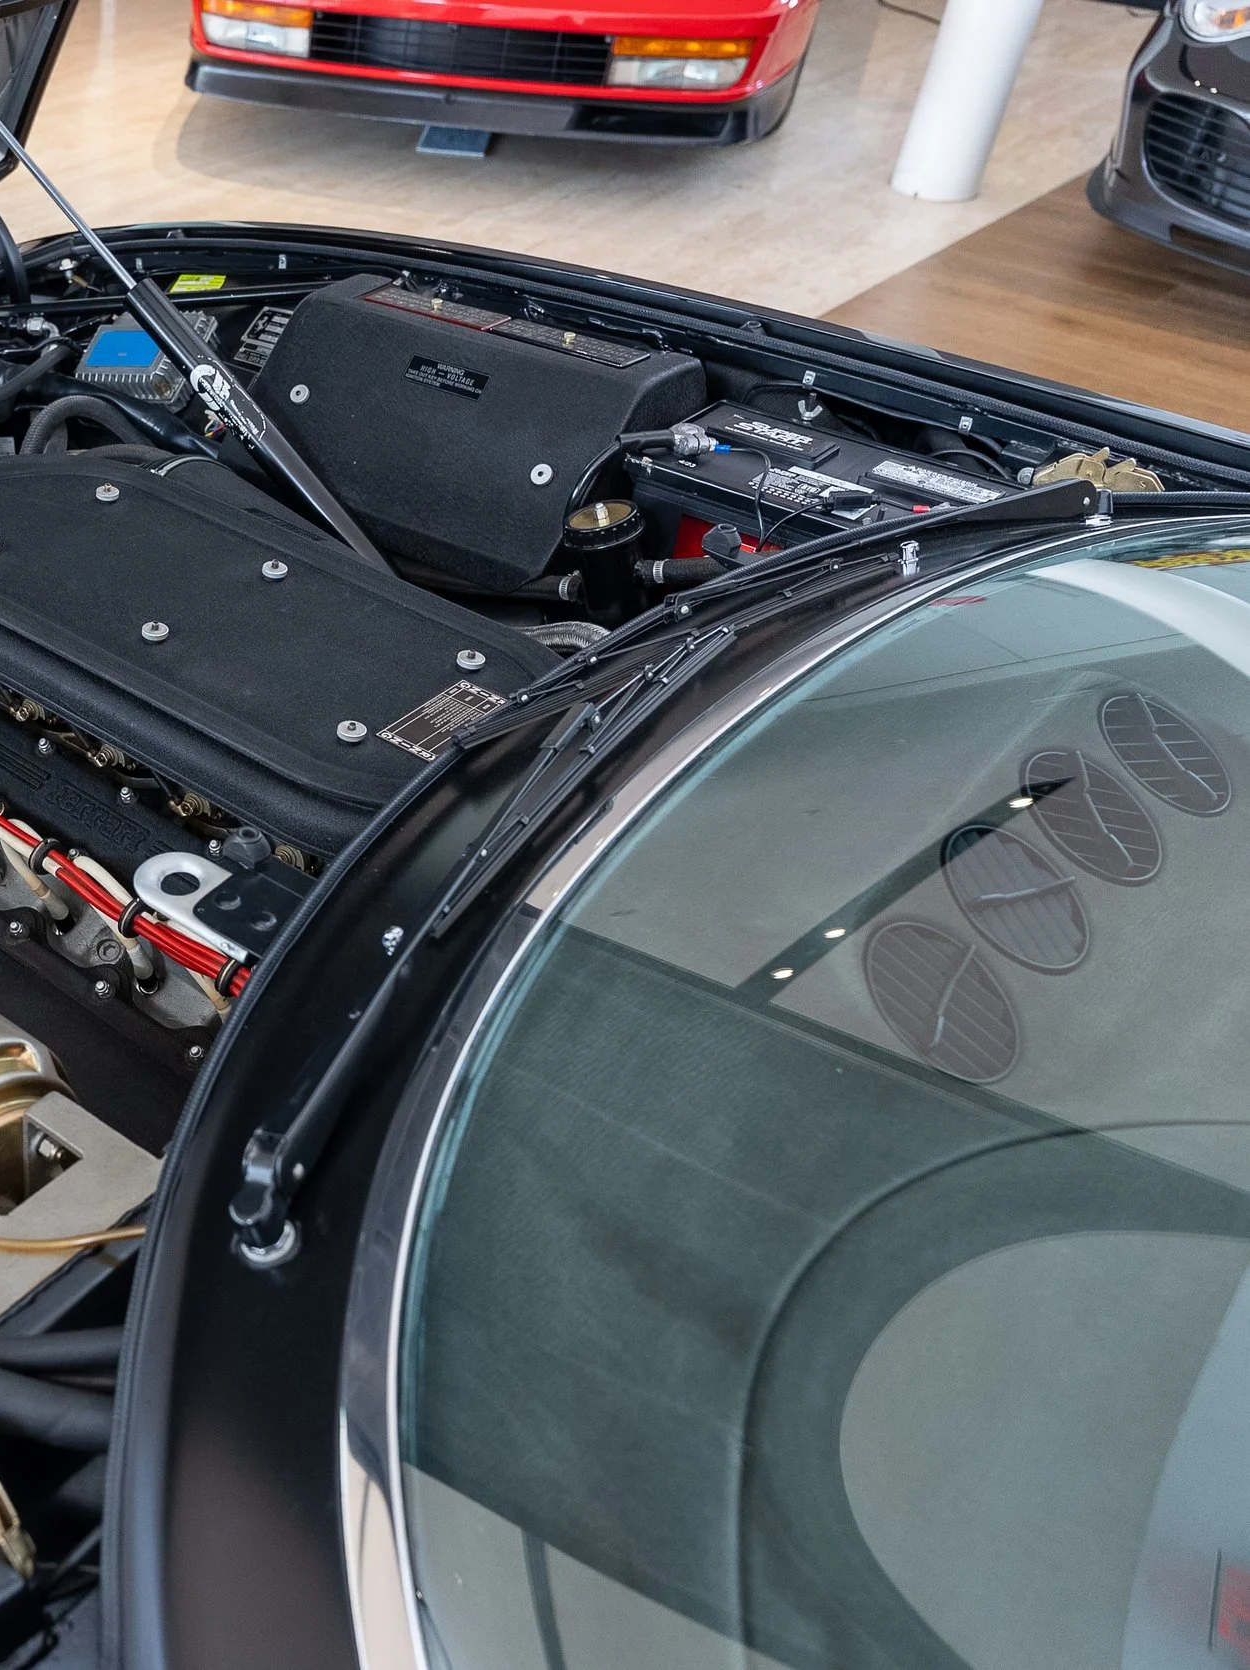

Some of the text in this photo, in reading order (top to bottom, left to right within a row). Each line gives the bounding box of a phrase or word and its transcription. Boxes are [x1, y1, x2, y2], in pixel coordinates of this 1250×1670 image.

[420, 365, 437, 374] HIGH
[447, 373, 475, 386] VOLTAGE
[437, 363, 465, 376] WARNING
[405, 373, 441, 387] IGNITION SYSTEM
[437, 376, 454, 387] BEFORE
[454, 381, 475, 393] WORKING
